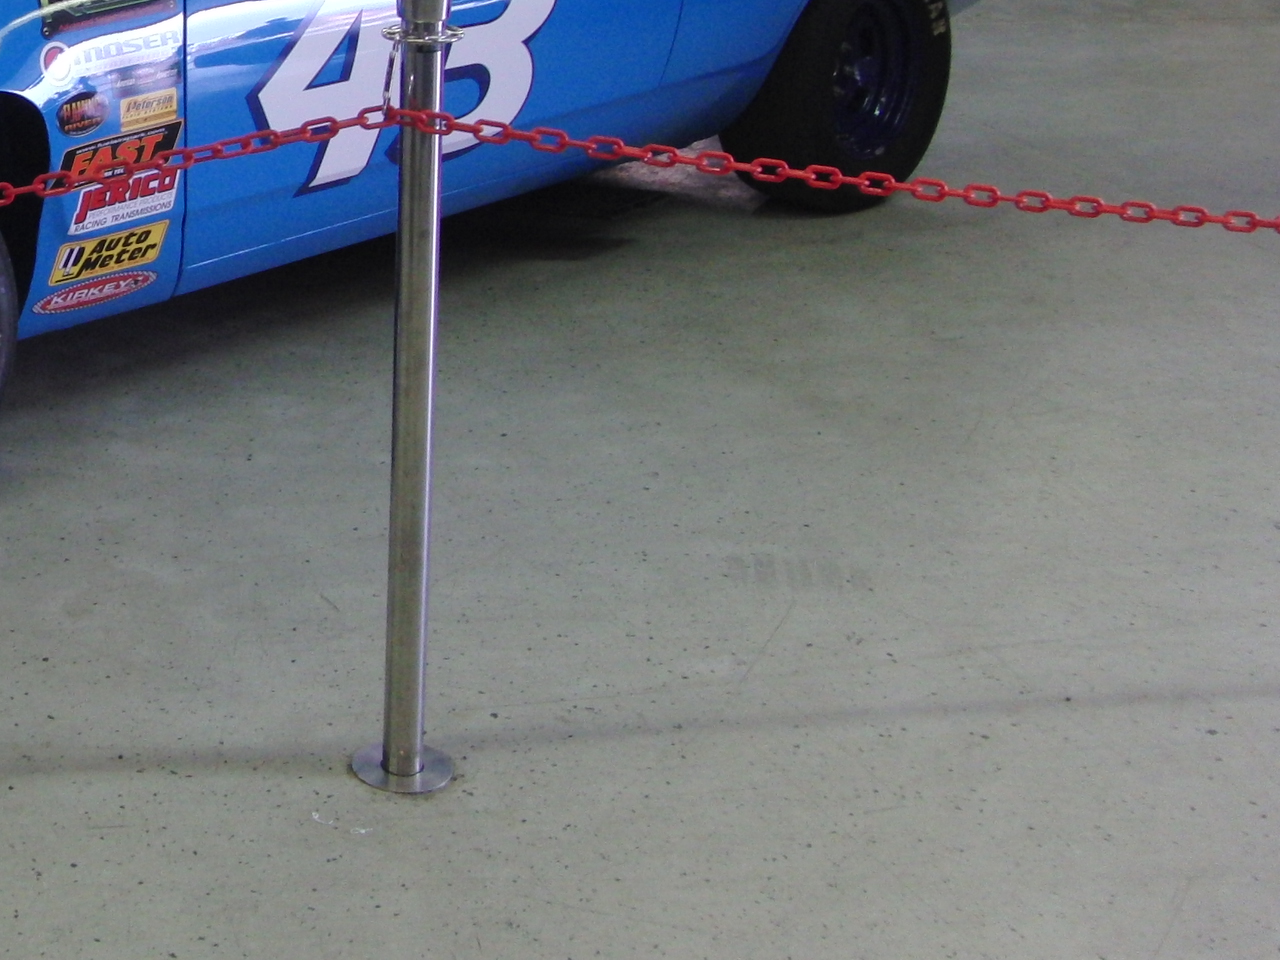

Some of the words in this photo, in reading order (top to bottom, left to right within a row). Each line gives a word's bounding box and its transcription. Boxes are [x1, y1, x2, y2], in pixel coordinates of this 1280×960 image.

[70, 132, 164, 179] FAST
[74, 170, 176, 225] JERICO
[74, 218, 108, 233] RACING
[111, 201, 172, 222] TRANSMISSIONS
[81, 243, 157, 271] Meter
[88, 230, 151, 256] Auto
[50, 279, 132, 307] KIRKEY
